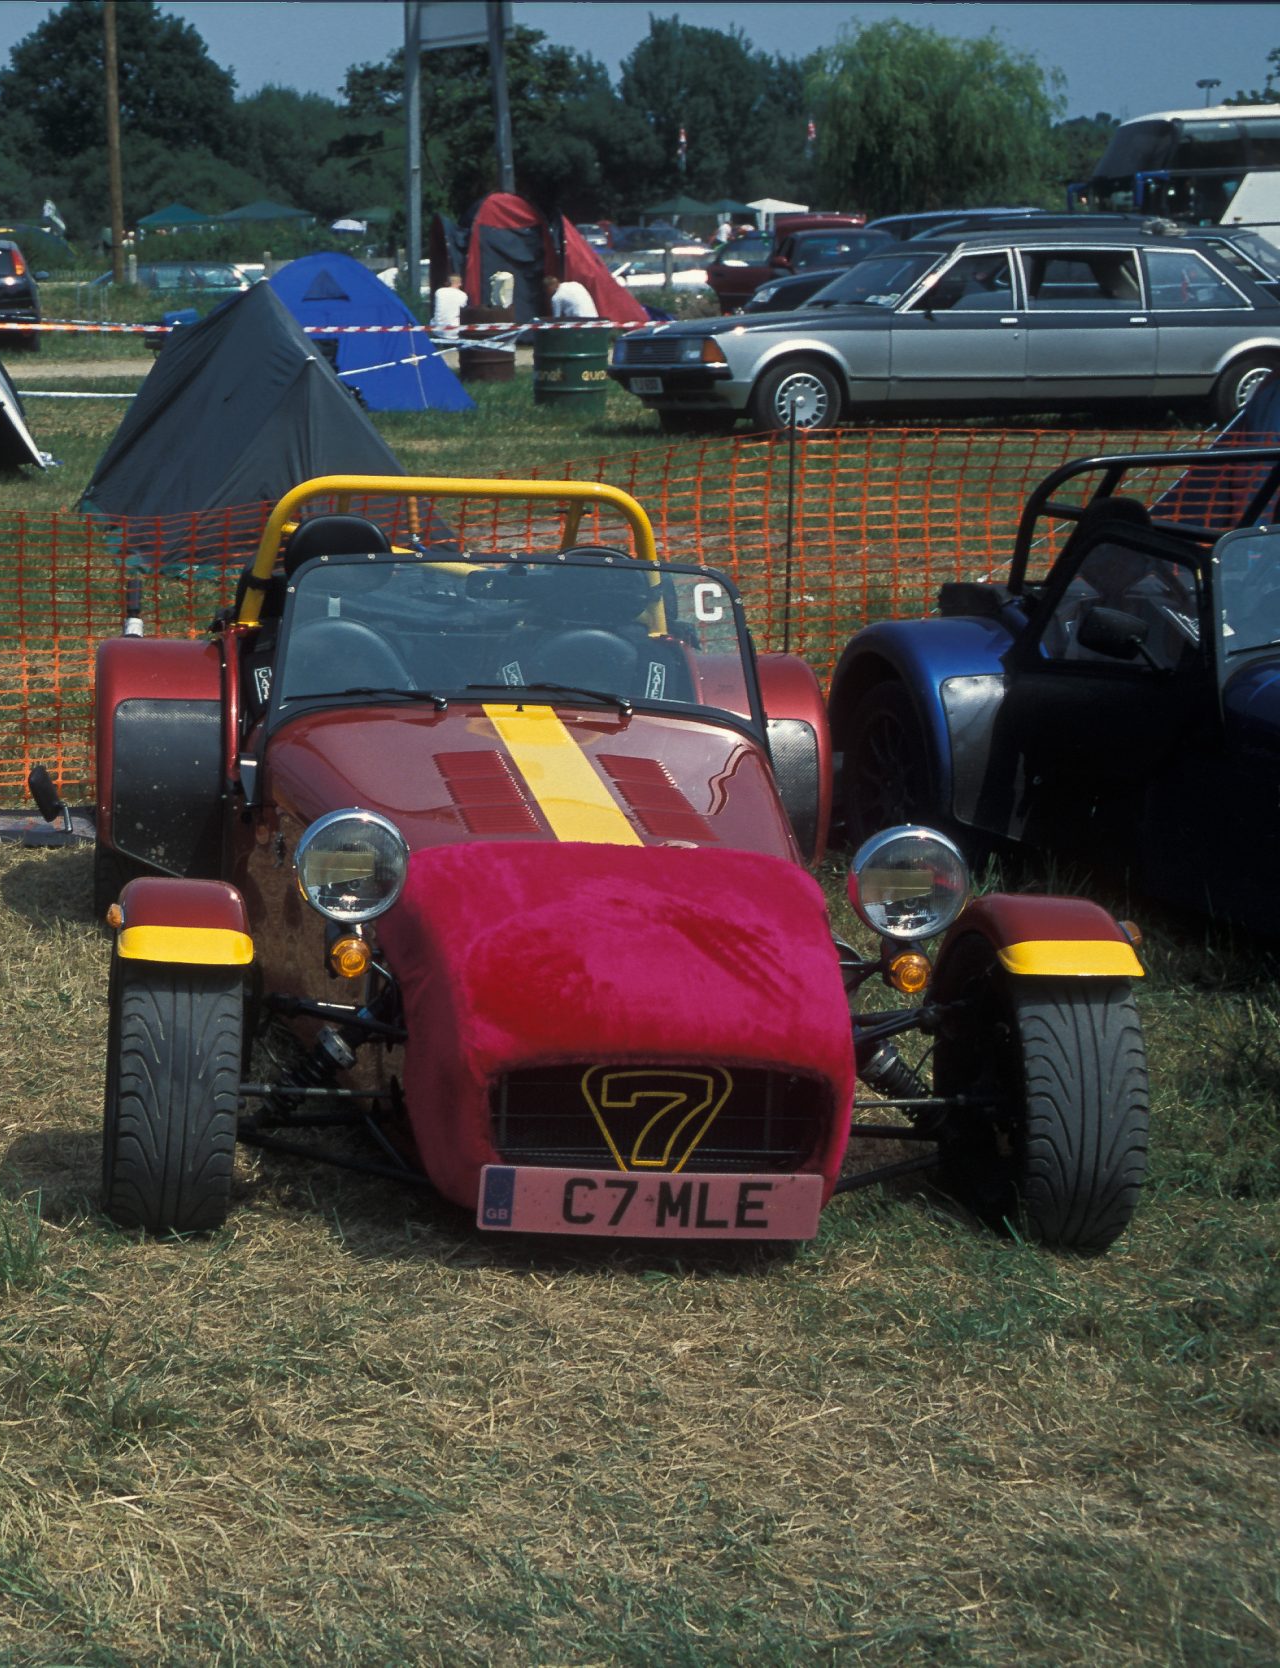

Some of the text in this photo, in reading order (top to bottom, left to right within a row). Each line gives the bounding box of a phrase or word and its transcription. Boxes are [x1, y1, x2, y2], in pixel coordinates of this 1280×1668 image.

[694, 583, 722, 621] C
[601, 1070, 714, 1166] 7
[486, 1208, 508, 1220] GB
[562, 1177, 774, 1229] C7 MLE
